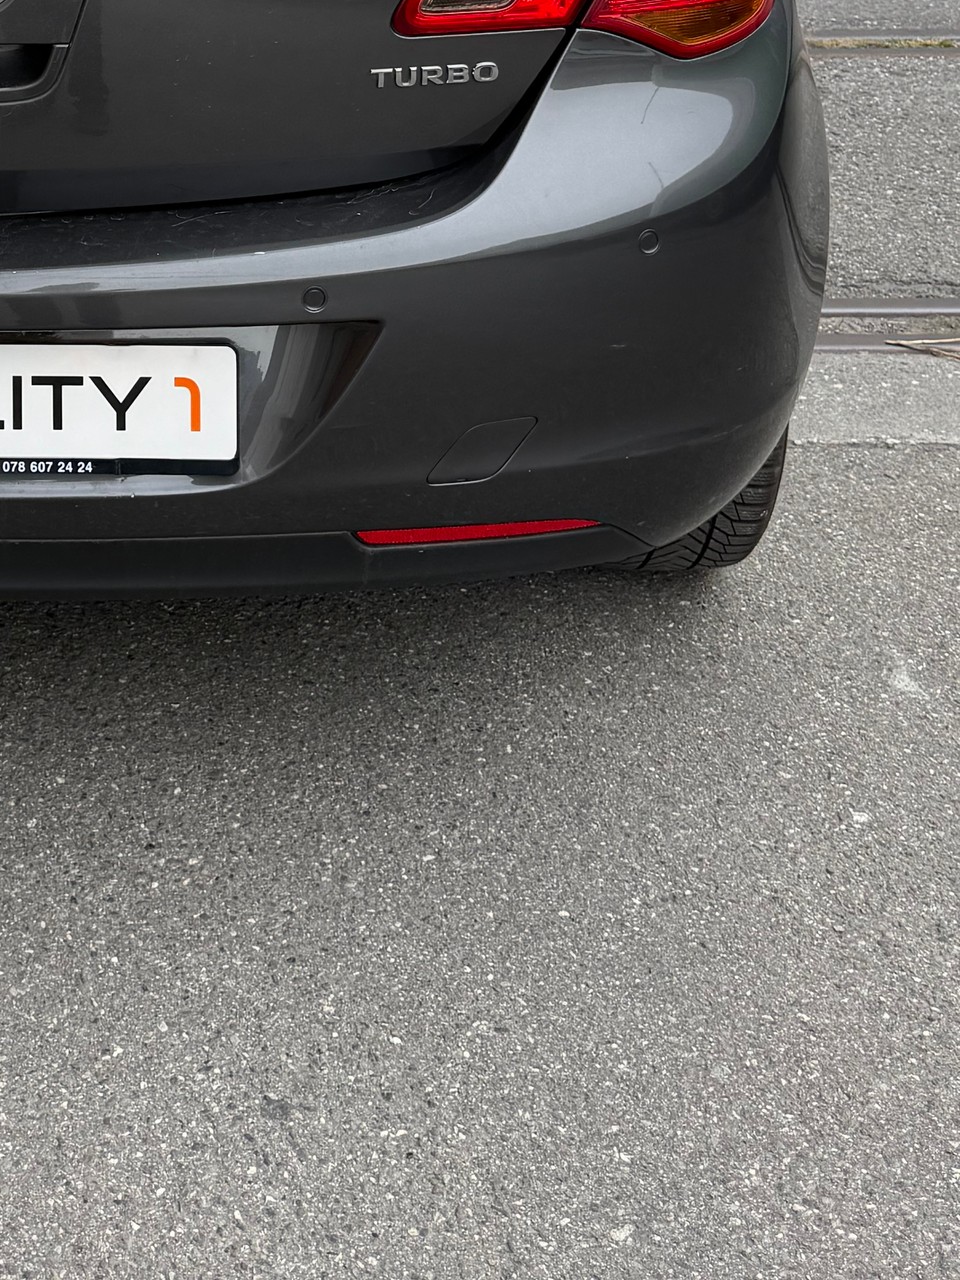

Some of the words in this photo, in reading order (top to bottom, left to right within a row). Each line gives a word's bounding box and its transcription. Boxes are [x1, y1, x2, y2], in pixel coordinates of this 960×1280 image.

[370, 61, 499, 88] TURBO
[173, 376, 201, 432] 1
[2, 459, 26, 472] 078
[30, 459, 53, 472] 607
[57, 459, 73, 472] 24
[77, 459, 93, 472] 24
